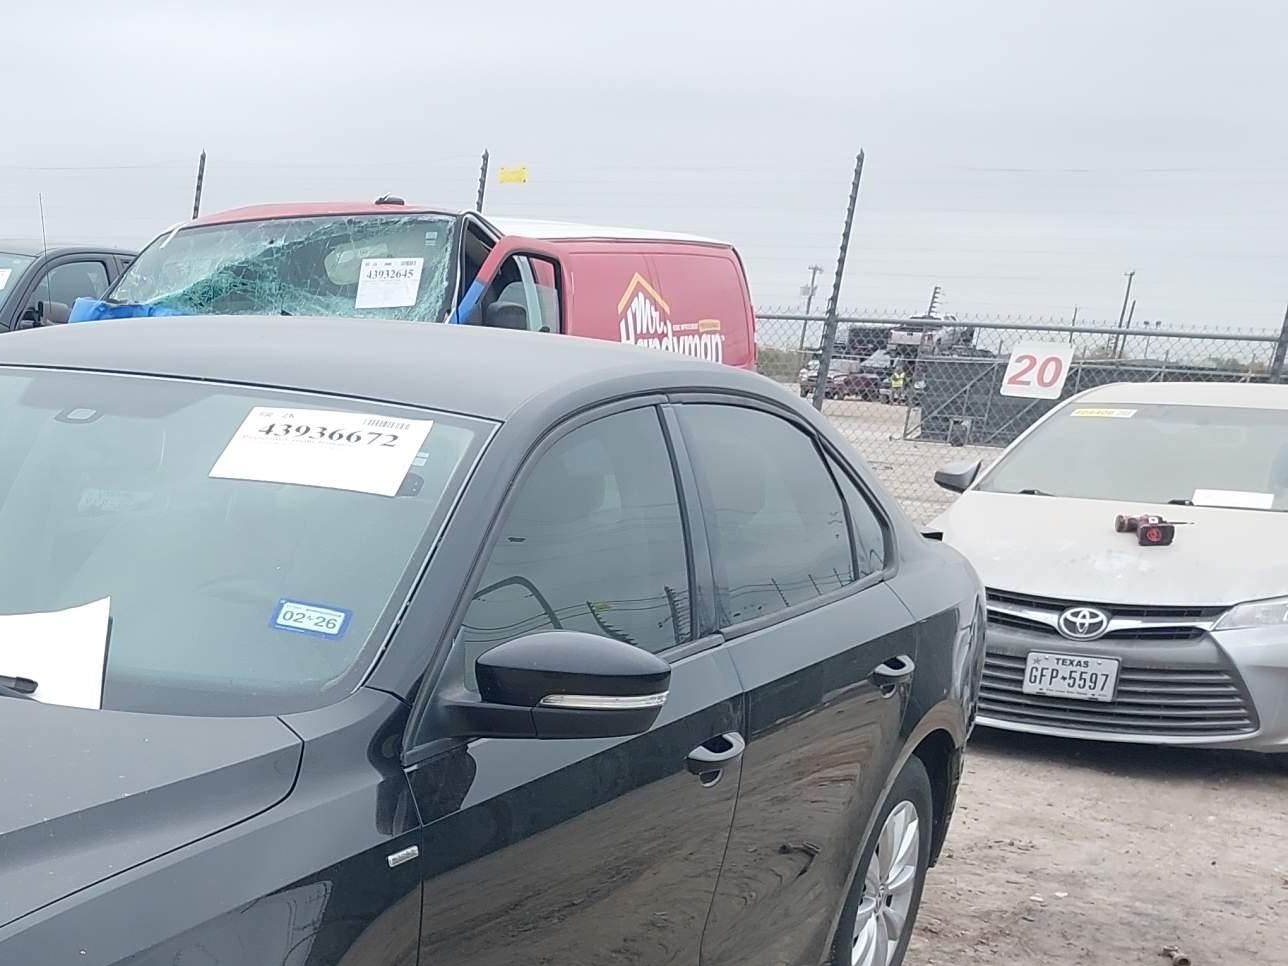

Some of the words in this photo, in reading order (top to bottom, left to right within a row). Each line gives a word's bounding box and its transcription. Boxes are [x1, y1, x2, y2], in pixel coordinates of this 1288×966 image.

[631, 290, 669, 335] Mr.
[1007, 354, 1063, 388] 20
[257, 423, 400, 448] 43936672
[1054, 657, 1090, 669] TEXAS
